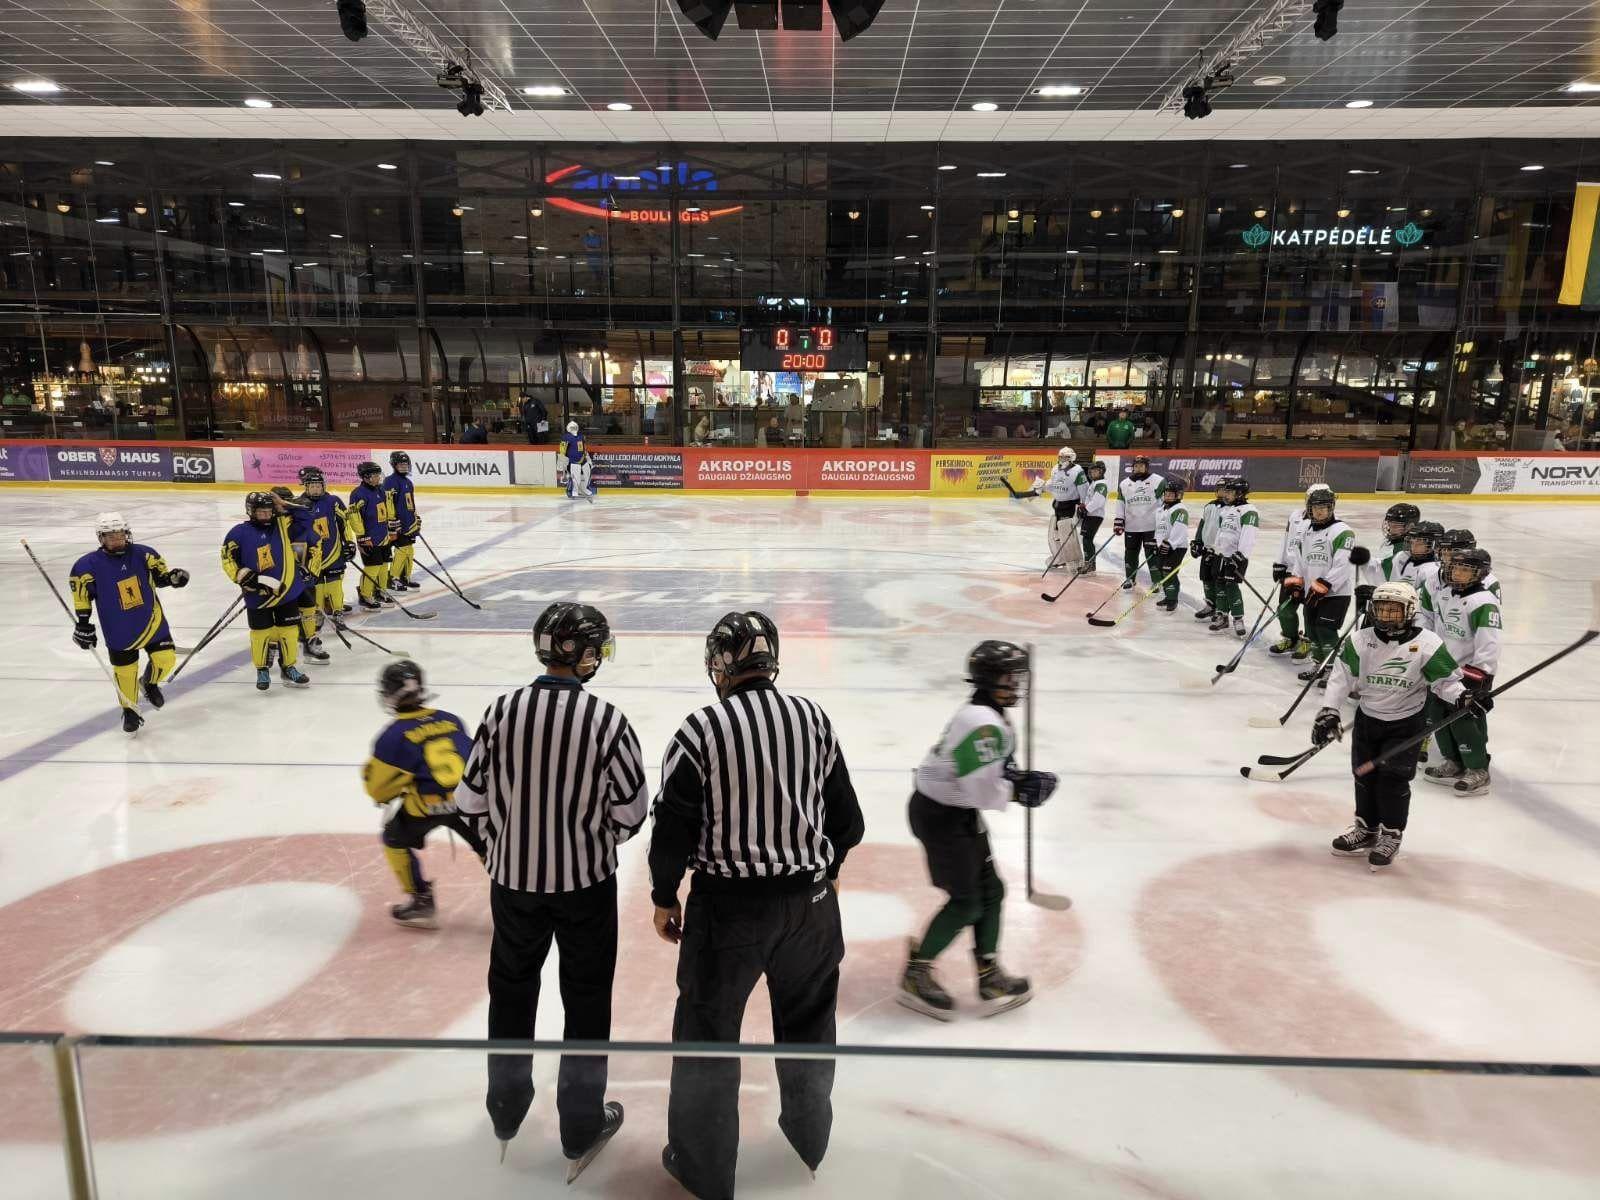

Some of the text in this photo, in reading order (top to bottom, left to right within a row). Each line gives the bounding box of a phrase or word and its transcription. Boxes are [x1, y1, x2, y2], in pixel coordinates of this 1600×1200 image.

[630, 210, 709, 223] BOULIGAS
[1273, 226, 1392, 245] KATPĖDĖLĖ
[777, 329, 788, 345] 0
[820, 329, 831, 345] 0
[783, 355, 824, 368] 20:00
[57, 451, 160, 464] OBER HAUS
[935, 460, 974, 468] PERSKINDOL
[415, 462, 501, 476] VALUMINA
[699, 461, 792, 472] AKROPOLIS
[822, 461, 916, 472] AKROPOLIS
[1168, 459, 1243, 470] ATEIK MOKYTIS
[698, 472, 792, 481] DAUGIAU DŽIAUGSMO
[821, 472, 915, 481] DAUGIAU DŽIAUGSMO
[1531, 466, 1600, 479] NORV
